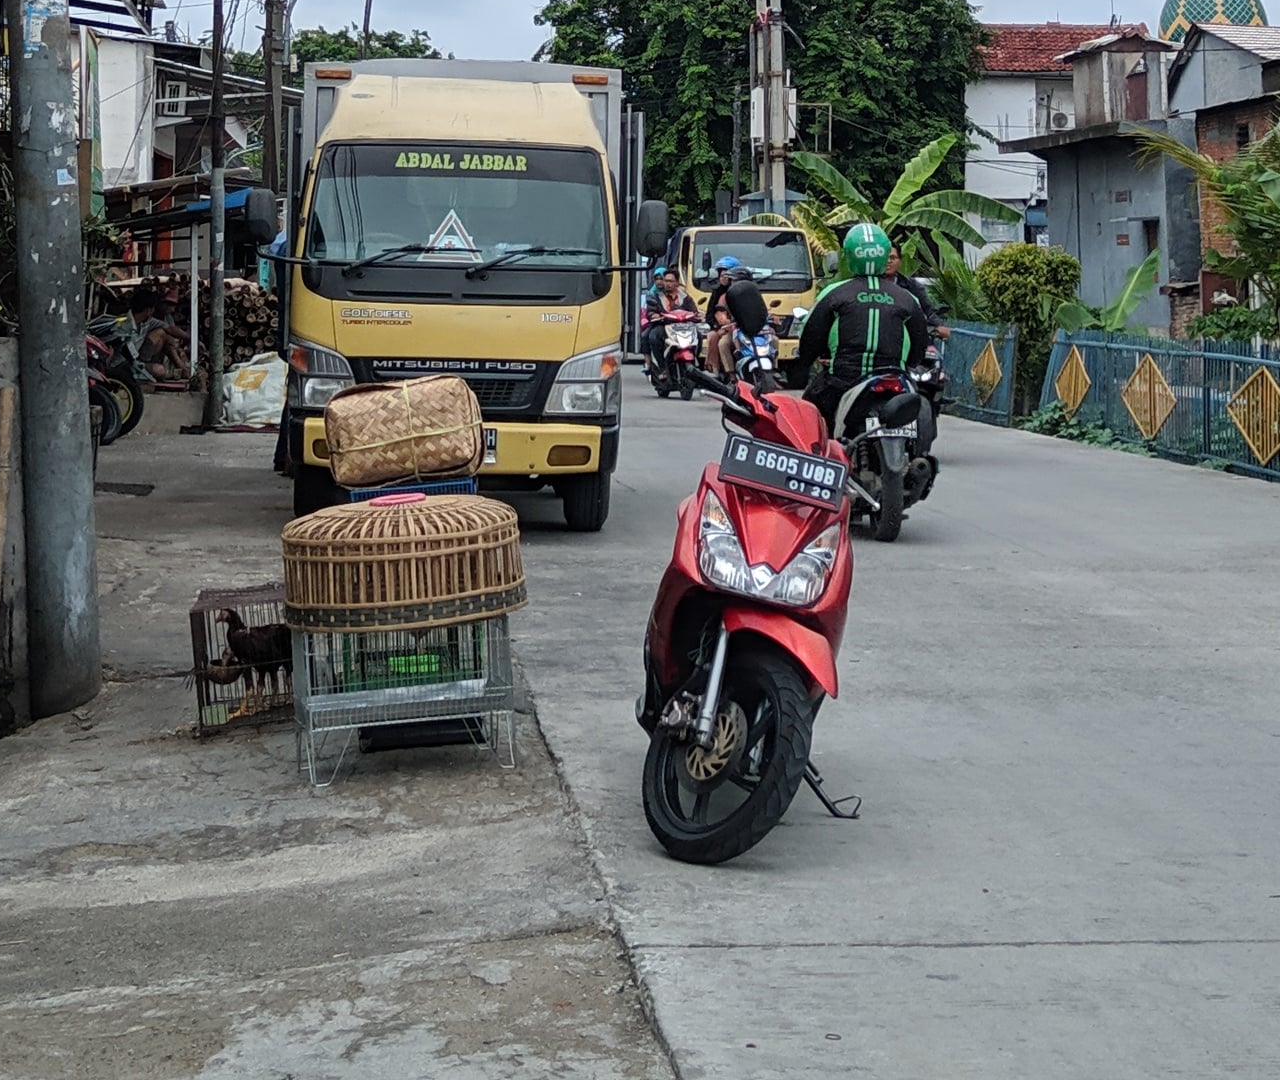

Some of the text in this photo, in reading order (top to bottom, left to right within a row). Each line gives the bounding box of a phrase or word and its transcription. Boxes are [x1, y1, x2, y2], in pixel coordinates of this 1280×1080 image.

[395, 152, 527, 171] ABDAL JABBAR
[854, 243, 885, 258] Grab
[856, 291, 895, 305] Grab
[372, 360, 537, 370] MITSUBISHI FUSO
[735, 444, 749, 461] B
[755, 450, 799, 475] 6605
